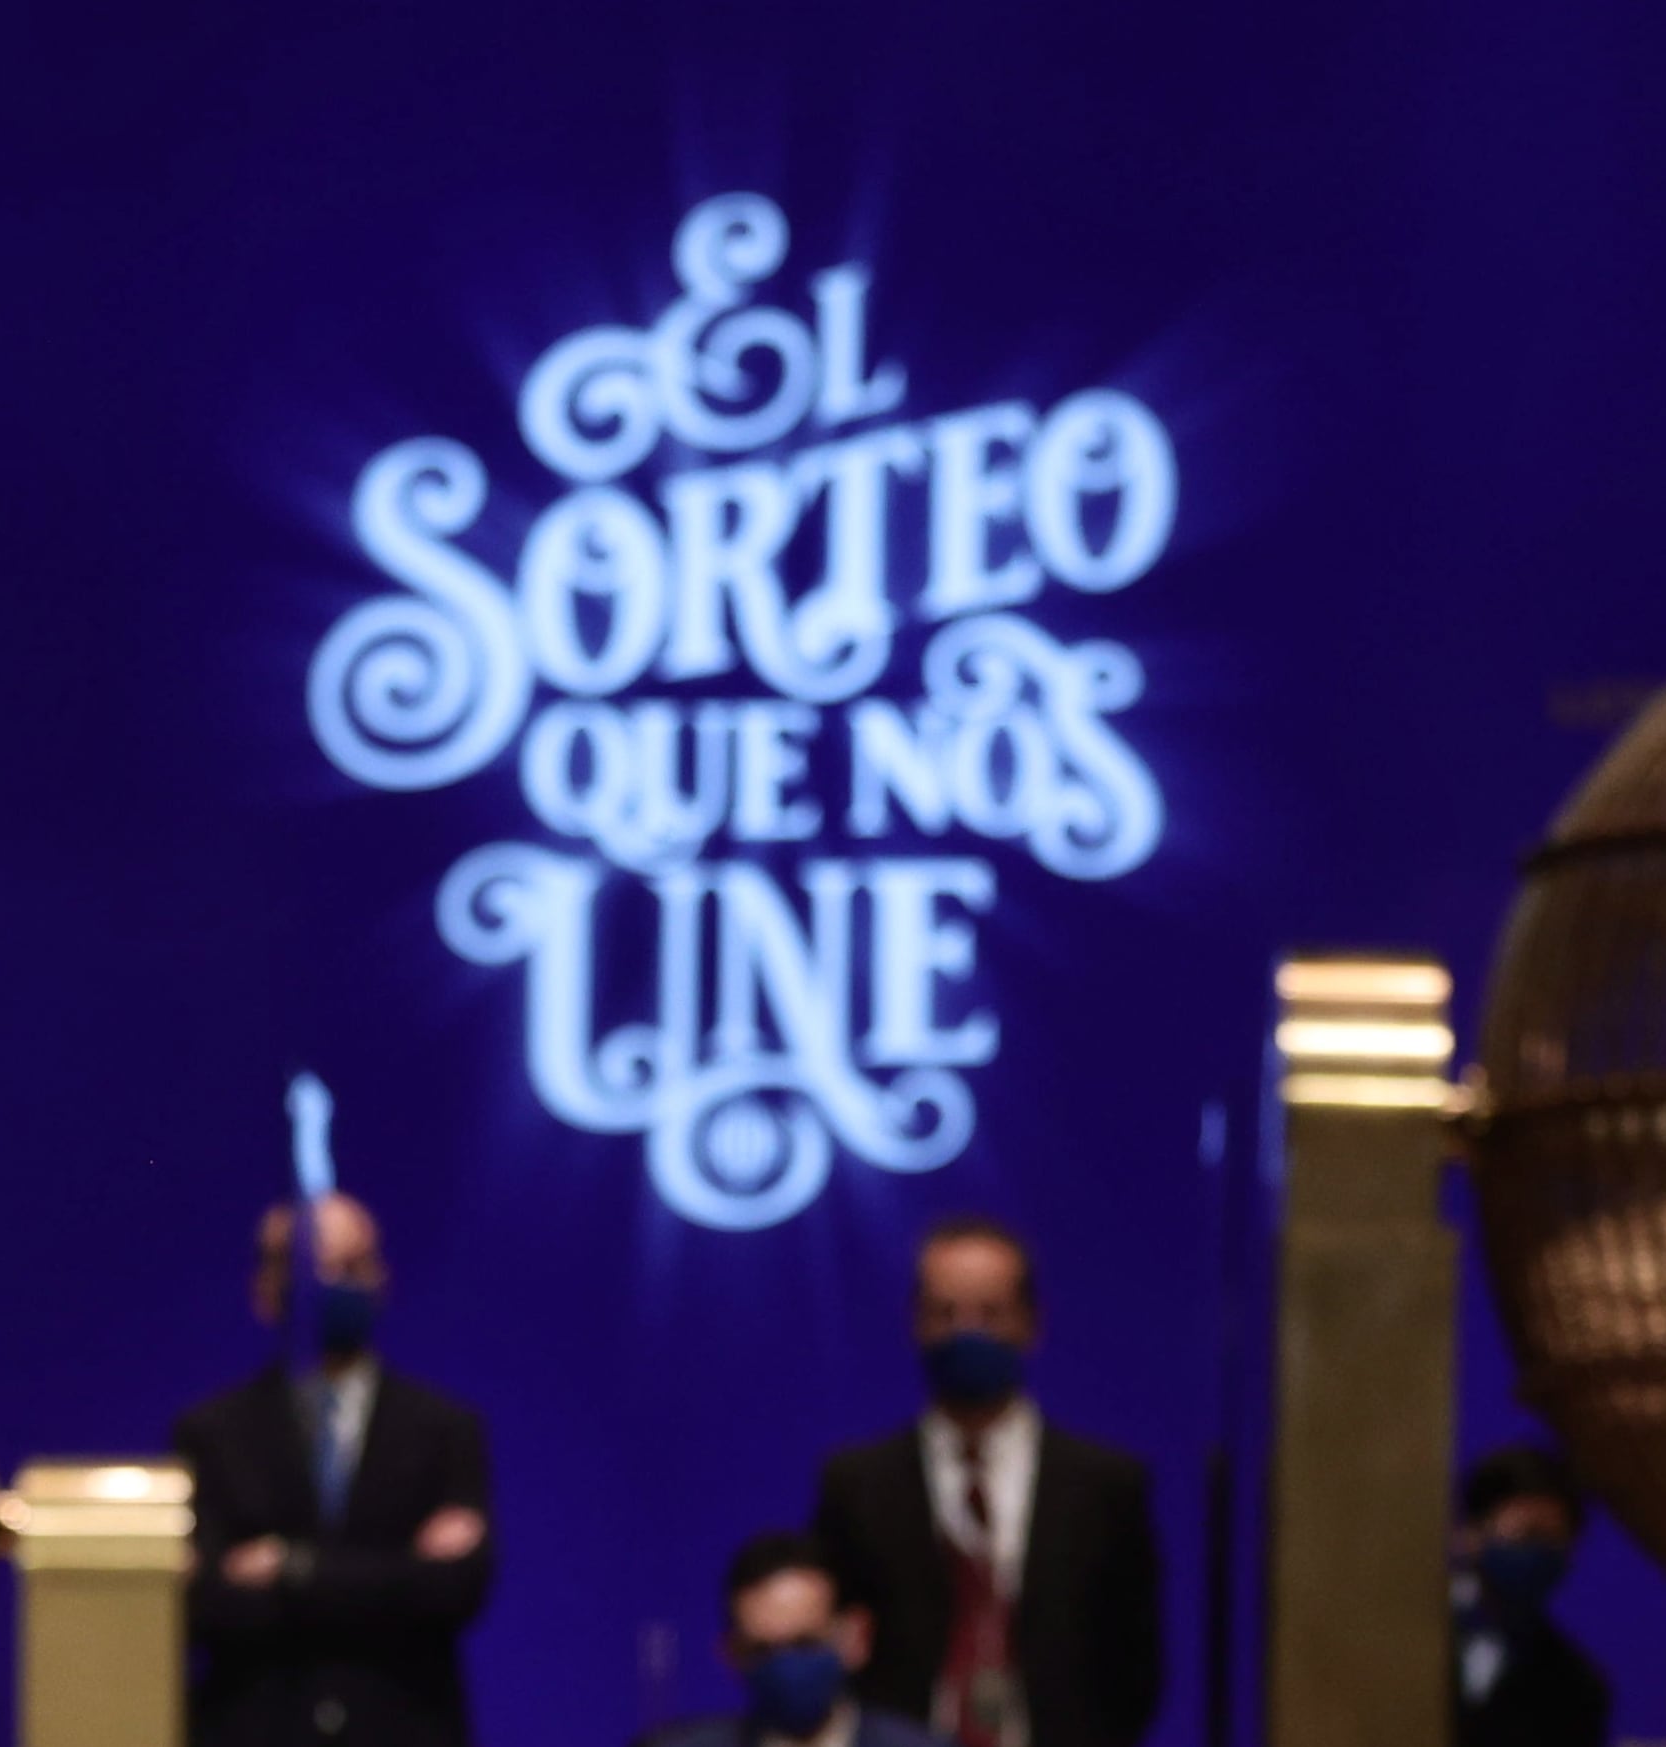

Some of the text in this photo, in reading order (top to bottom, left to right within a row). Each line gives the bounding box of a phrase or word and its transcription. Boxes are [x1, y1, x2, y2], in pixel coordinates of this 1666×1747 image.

[519, 190, 908, 483] EL
[306, 387, 1178, 792] SORTEO
[519, 611, 1166, 882] QUE NOS
[434, 842, 1000, 1232] UNE
